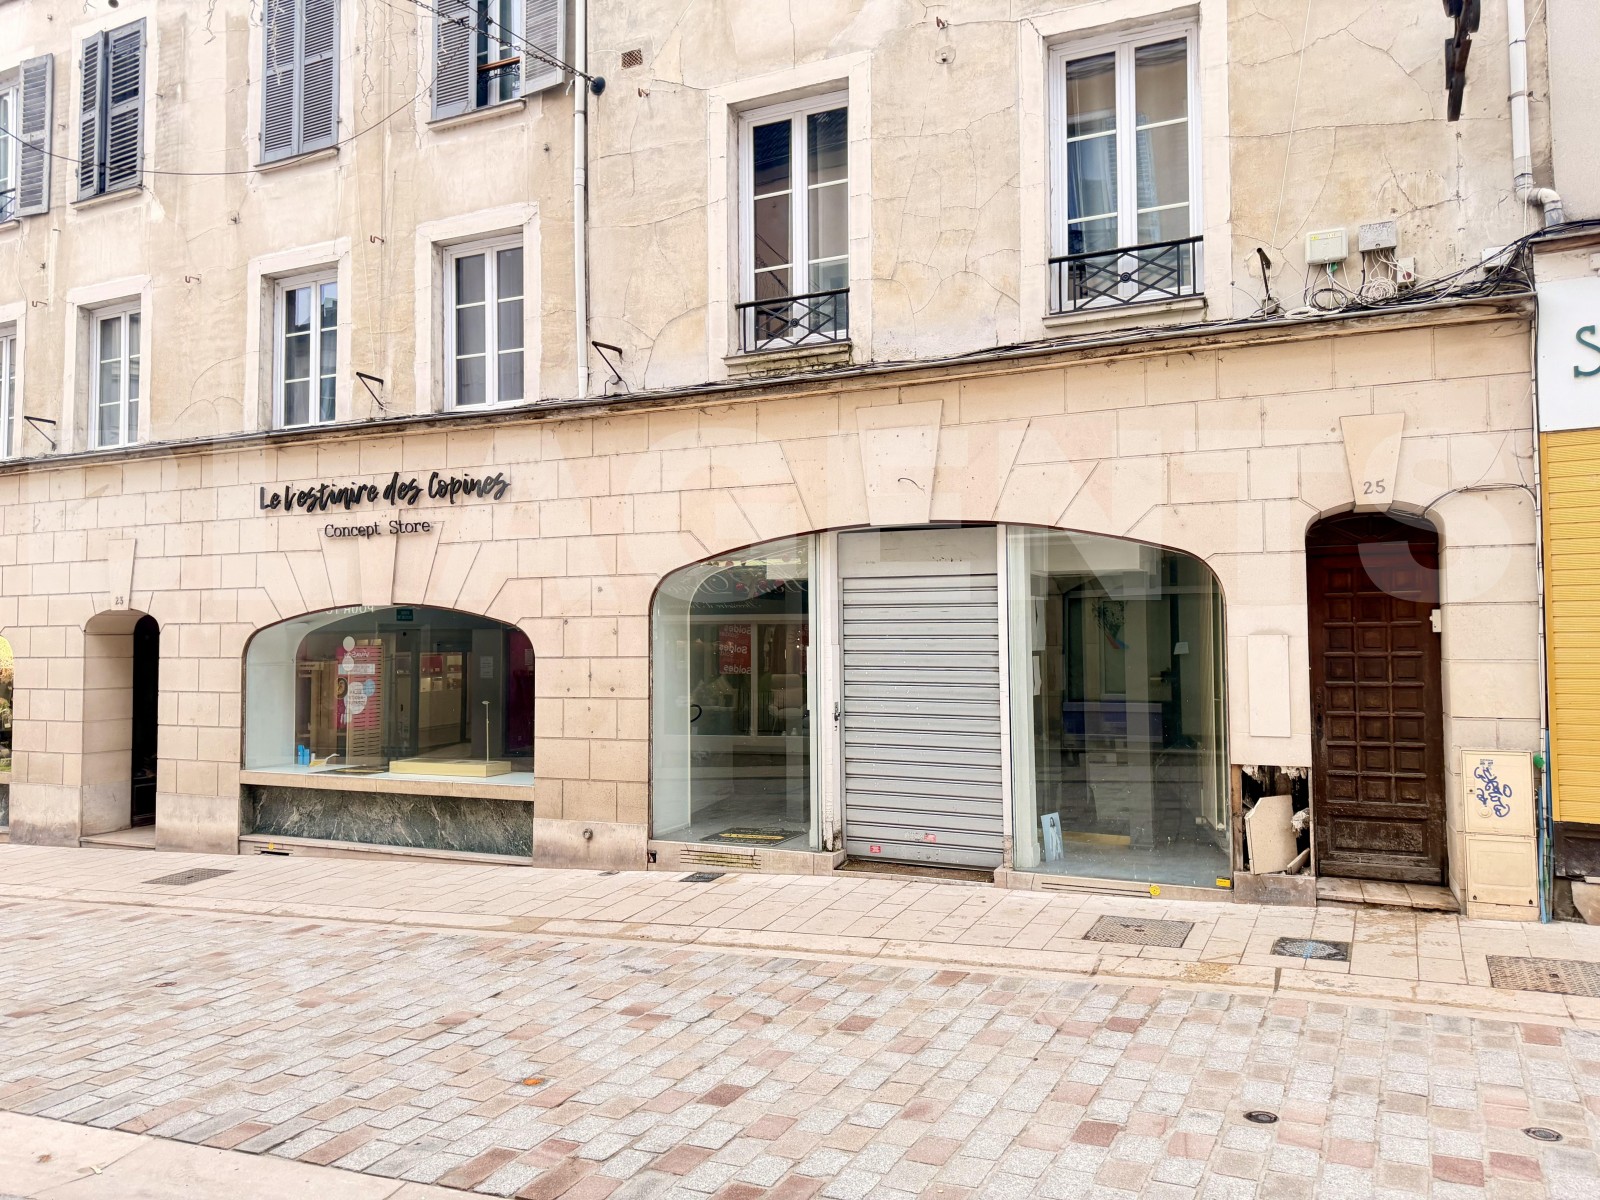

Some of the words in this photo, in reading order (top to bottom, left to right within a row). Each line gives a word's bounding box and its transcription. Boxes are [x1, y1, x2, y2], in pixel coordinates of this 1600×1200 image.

[260, 486, 281, 510] Le
[383, 472, 423, 506] des
[428, 471, 511, 504] Copines
[1363, 478, 1386, 495] 25
[325, 523, 380, 539] Concept
[389, 520, 431, 535] Store
[115, 596, 124, 605] 23
